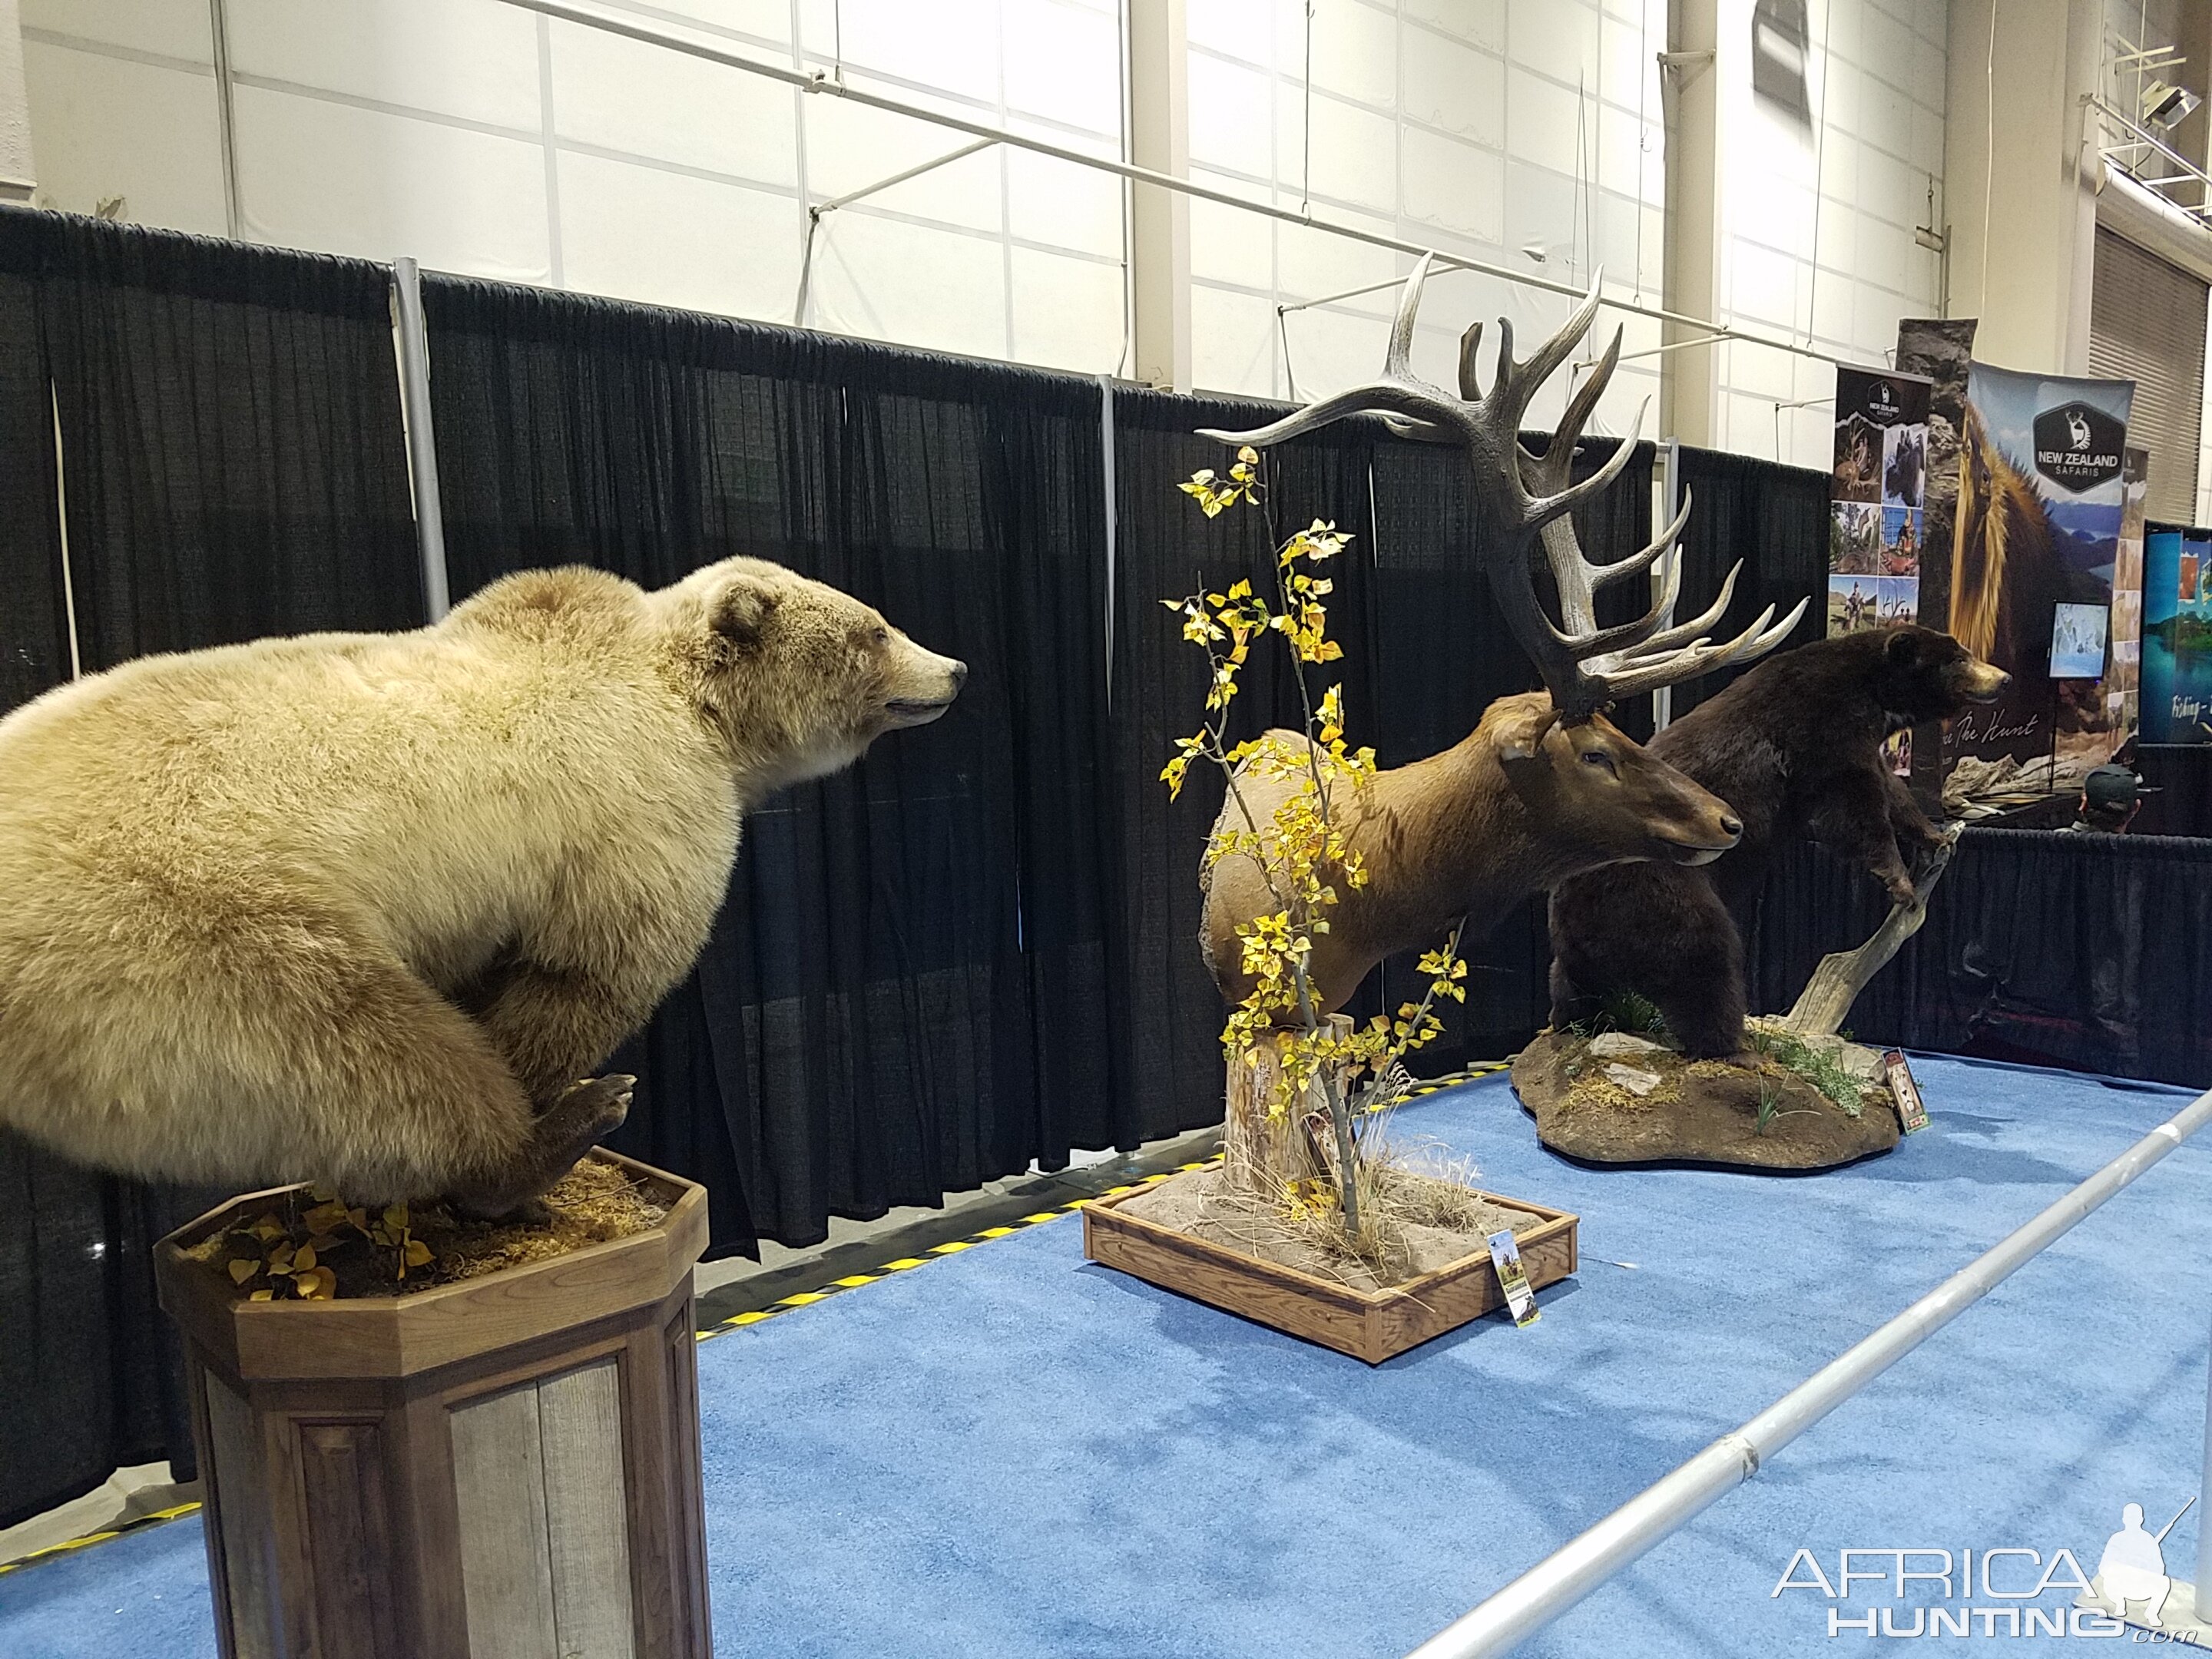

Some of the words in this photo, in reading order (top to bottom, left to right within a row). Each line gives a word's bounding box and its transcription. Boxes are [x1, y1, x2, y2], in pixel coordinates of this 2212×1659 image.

[2038, 451, 2063, 464] NEW
[2065, 453, 2118, 467] ZEALAND
[2055, 465, 2099, 477] SAFARIS
[1955, 710, 1979, 749] The
[1981, 708, 2039, 743] Hunt
